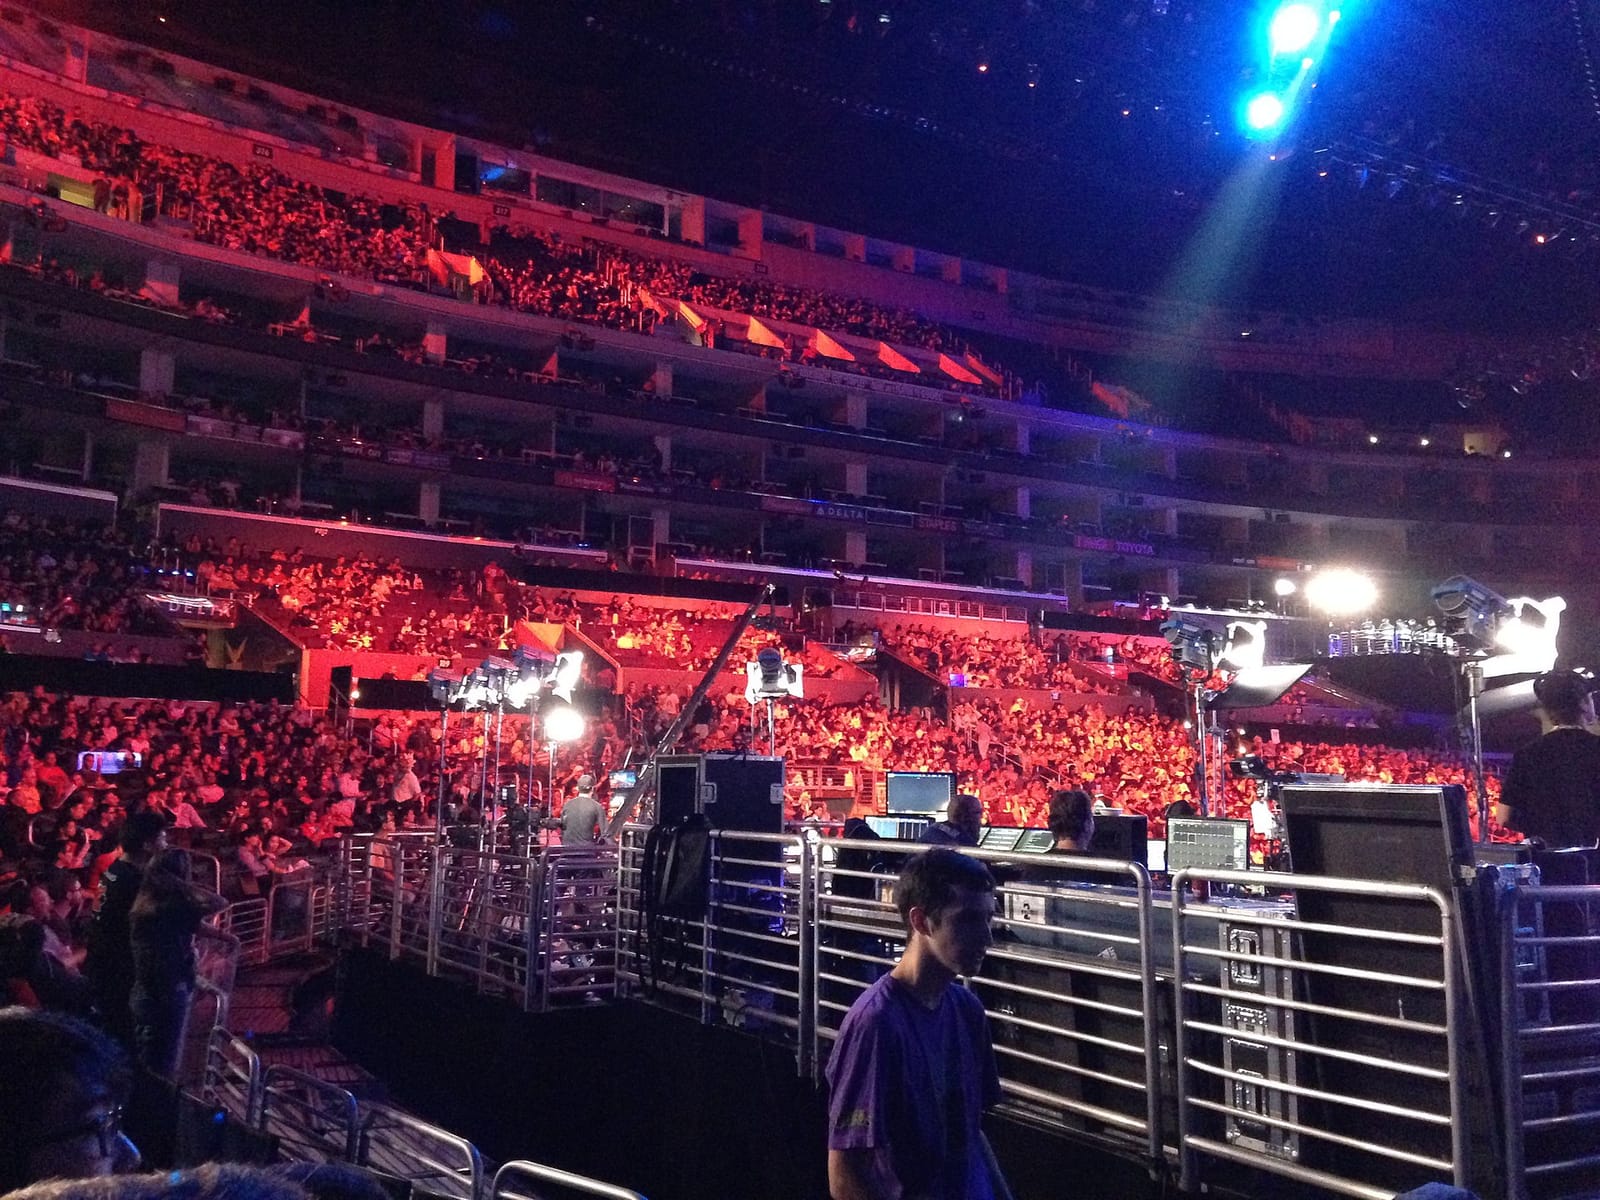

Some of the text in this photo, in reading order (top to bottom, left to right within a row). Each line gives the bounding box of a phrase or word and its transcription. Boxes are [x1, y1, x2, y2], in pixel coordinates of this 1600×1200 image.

[828, 507, 865, 519] DELTA
[1116, 540, 1154, 554] TOYOTA
[169, 602, 231, 618] DELTA
